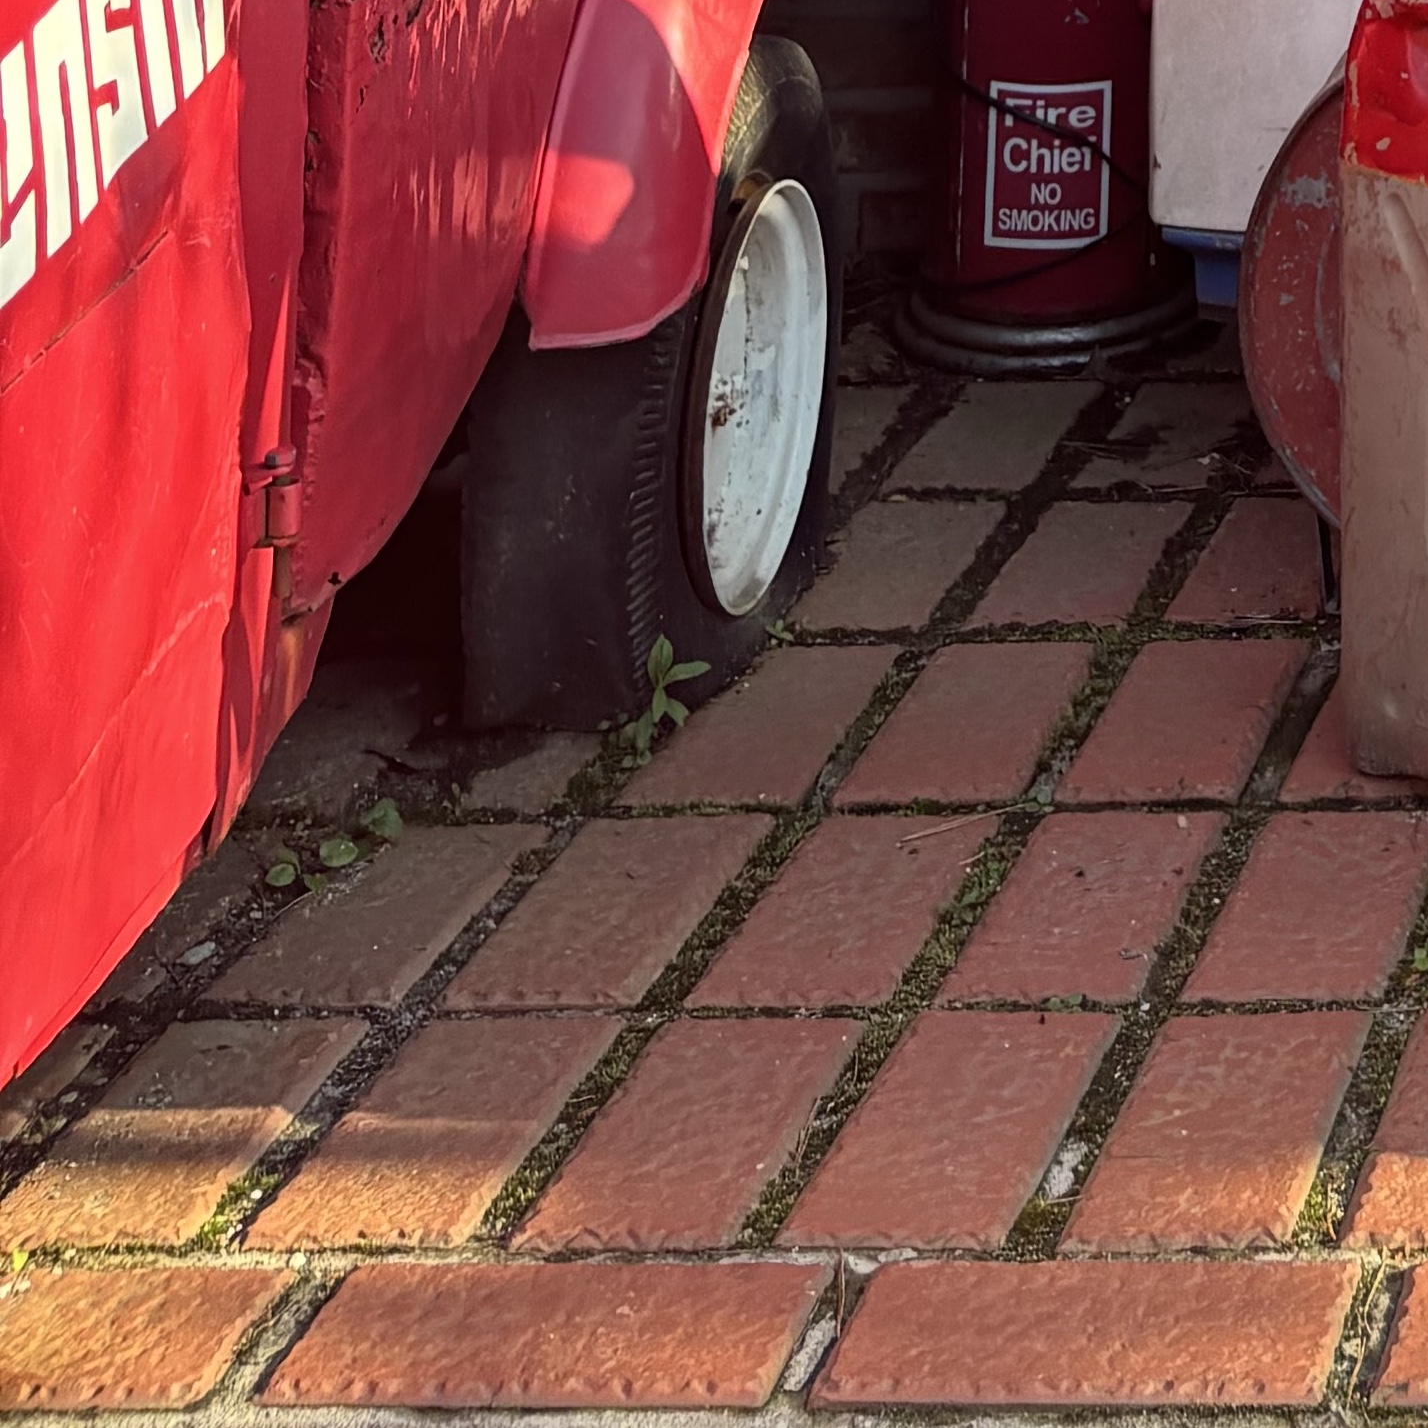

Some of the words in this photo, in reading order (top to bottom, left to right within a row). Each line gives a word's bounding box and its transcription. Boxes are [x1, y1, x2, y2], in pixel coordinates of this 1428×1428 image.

[1004, 97, 1097, 128] Fire
[1003, 135, 1097, 174] Chief
[1030, 183, 1062, 205] NO
[998, 208, 1095, 232] SMOKING
